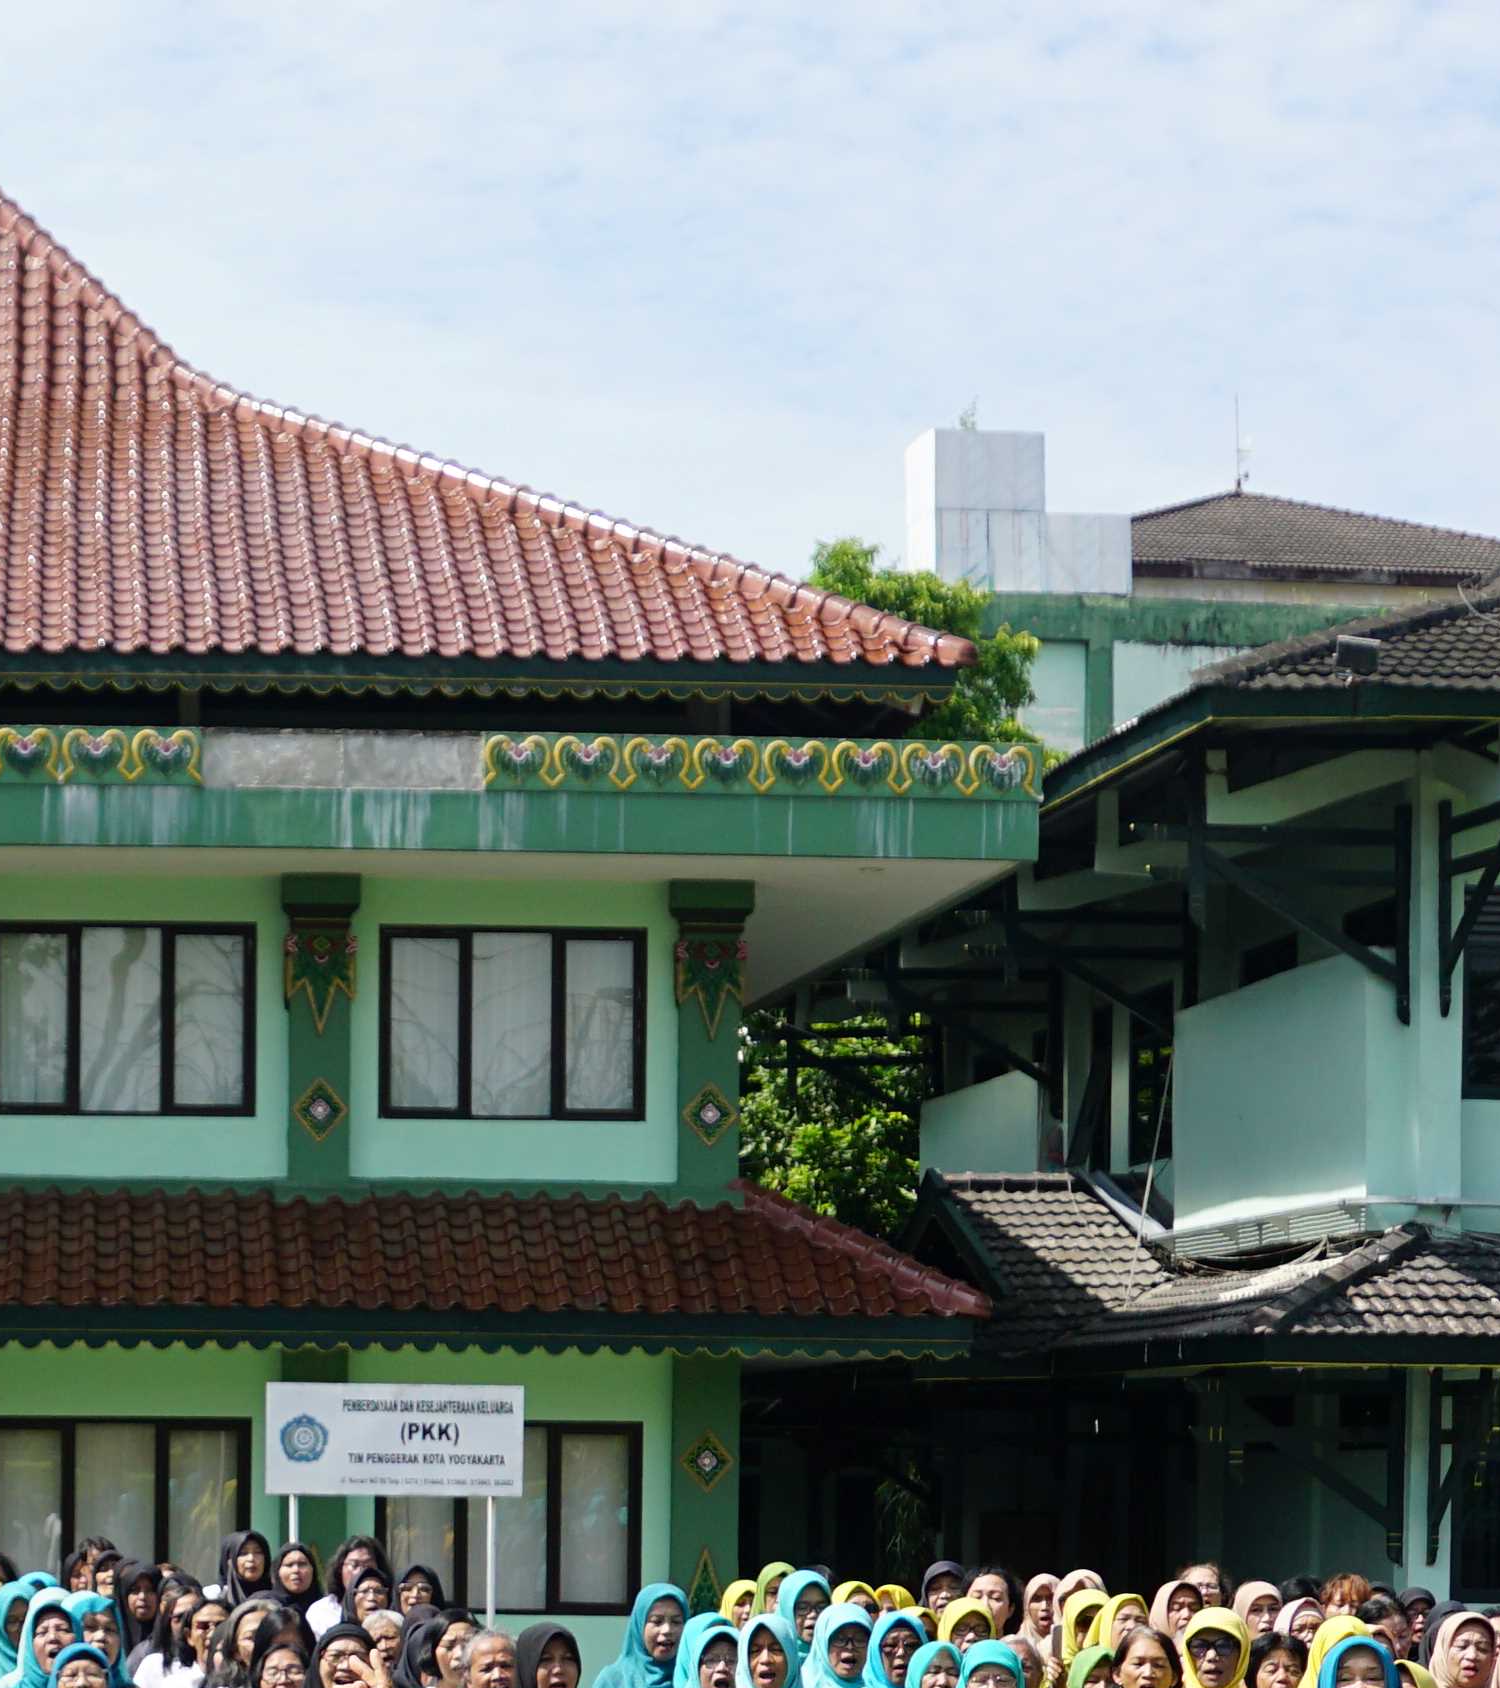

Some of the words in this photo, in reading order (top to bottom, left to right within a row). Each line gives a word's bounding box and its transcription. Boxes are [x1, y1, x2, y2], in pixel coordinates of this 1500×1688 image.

[400, 1400, 414, 1413] DAN
[477, 1401, 514, 1415] KELUARGA
[400, 1422, 460, 1446] (PKK)
[348, 1452, 364, 1464] TIM
[366, 1452, 420, 1464] PENGGERAK
[423, 1453, 446, 1465] KOTA
[449, 1453, 505, 1466] YOGYAKARTA
